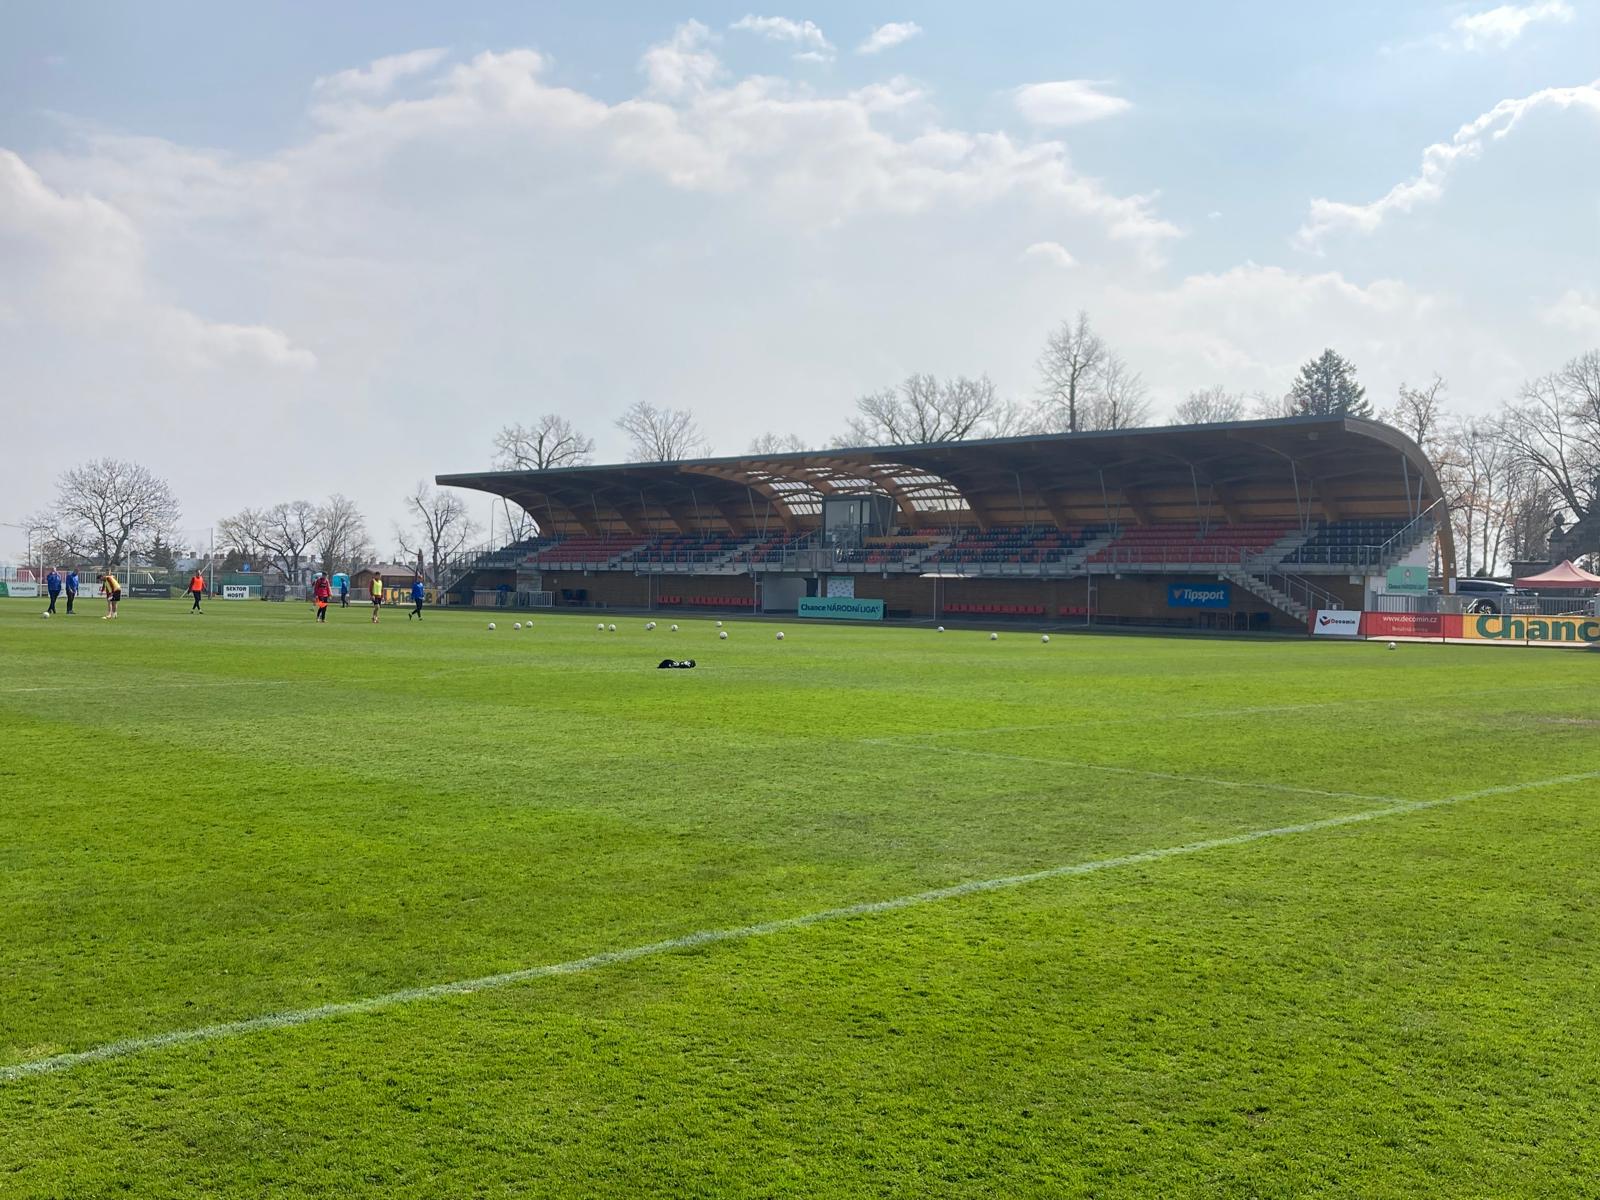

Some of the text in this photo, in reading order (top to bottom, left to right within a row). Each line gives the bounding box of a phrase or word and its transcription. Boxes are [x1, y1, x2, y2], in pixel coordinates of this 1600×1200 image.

[1184, 589, 1224, 603] Tipsport
[801, 603, 826, 611] Chance
[1383, 615, 1437, 623] www.decomin.cz
